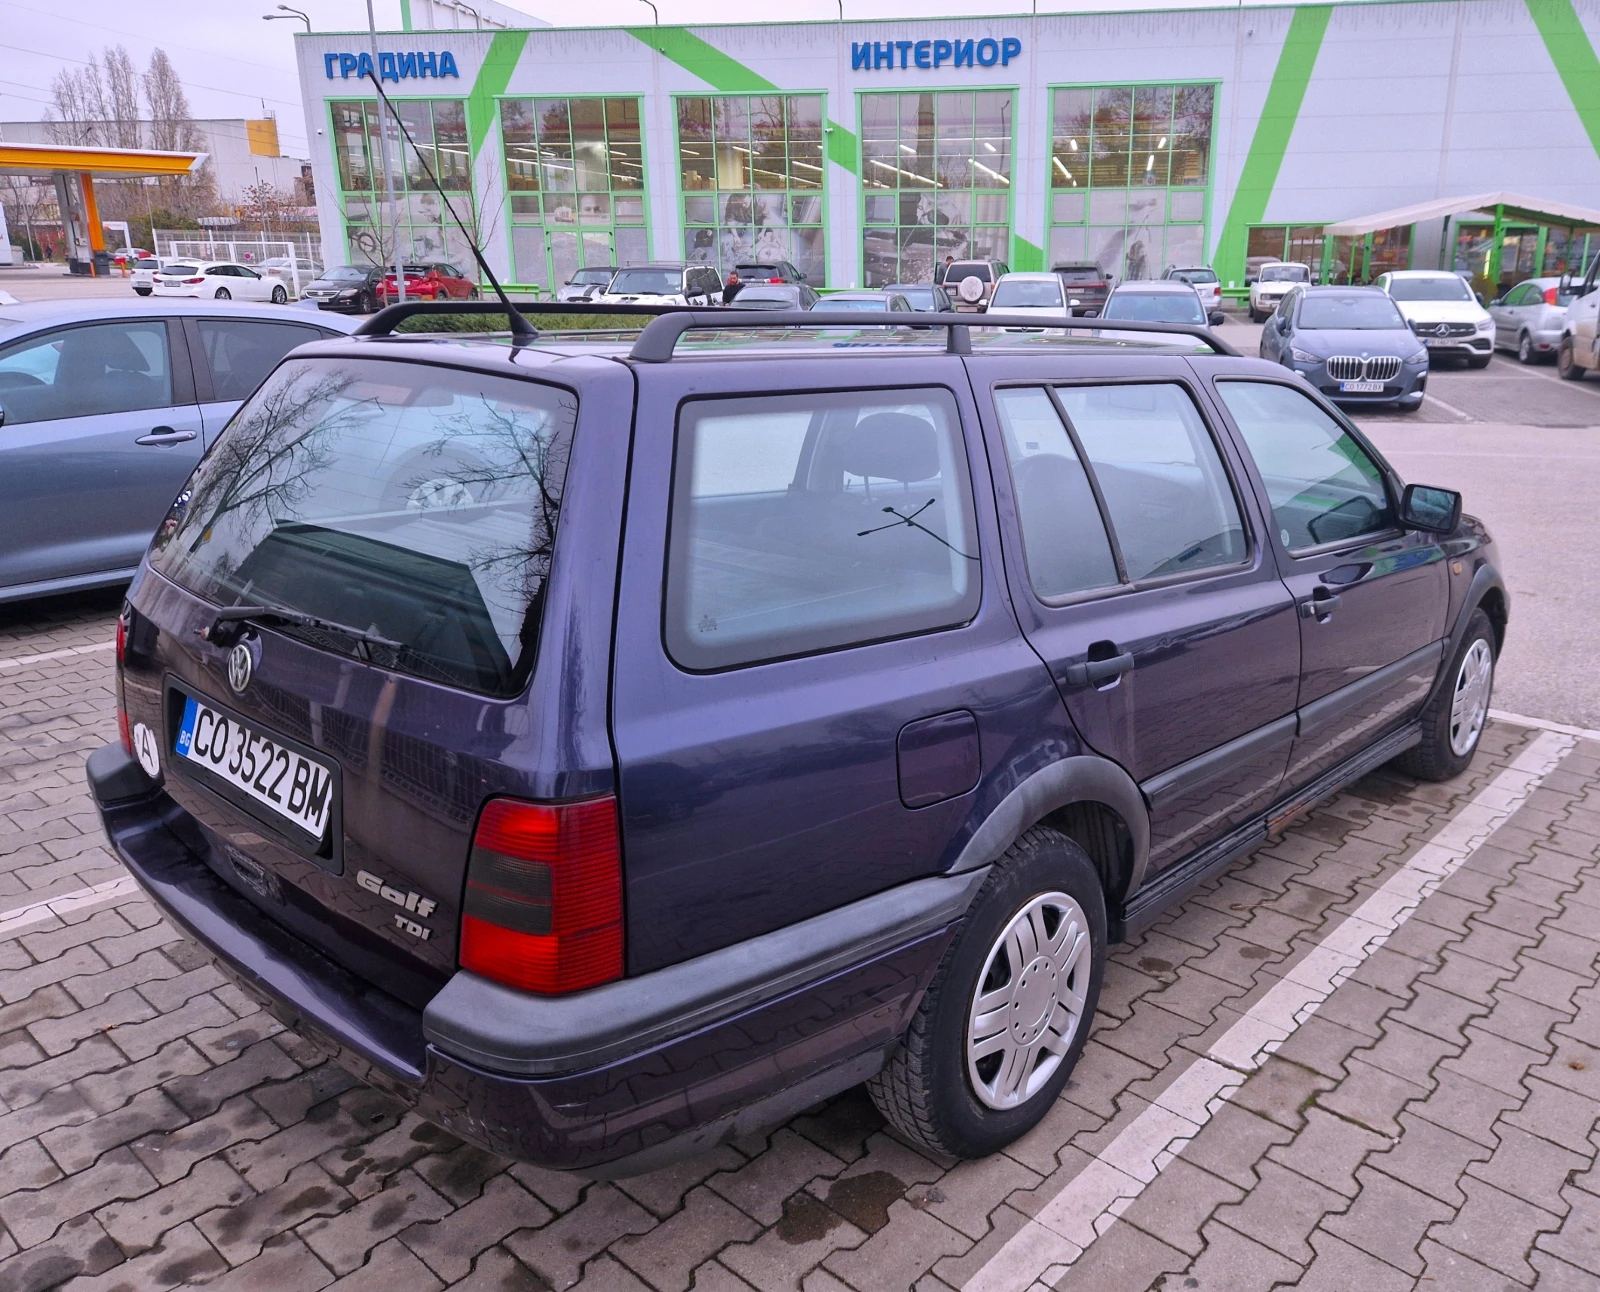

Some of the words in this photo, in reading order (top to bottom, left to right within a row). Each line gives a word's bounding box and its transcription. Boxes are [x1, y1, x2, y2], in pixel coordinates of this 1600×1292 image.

[323, 51, 460, 84] ГРАДИНА
[851, 37, 1022, 71] ИНТЕРИОР
[1356, 383, 1373, 391] 1772
[179, 730, 191, 747] BG
[228, 725, 290, 805] 3522
[287, 758, 331, 828] BM
[356, 869, 438, 918] Golf
[394, 913, 432, 941] TDI
